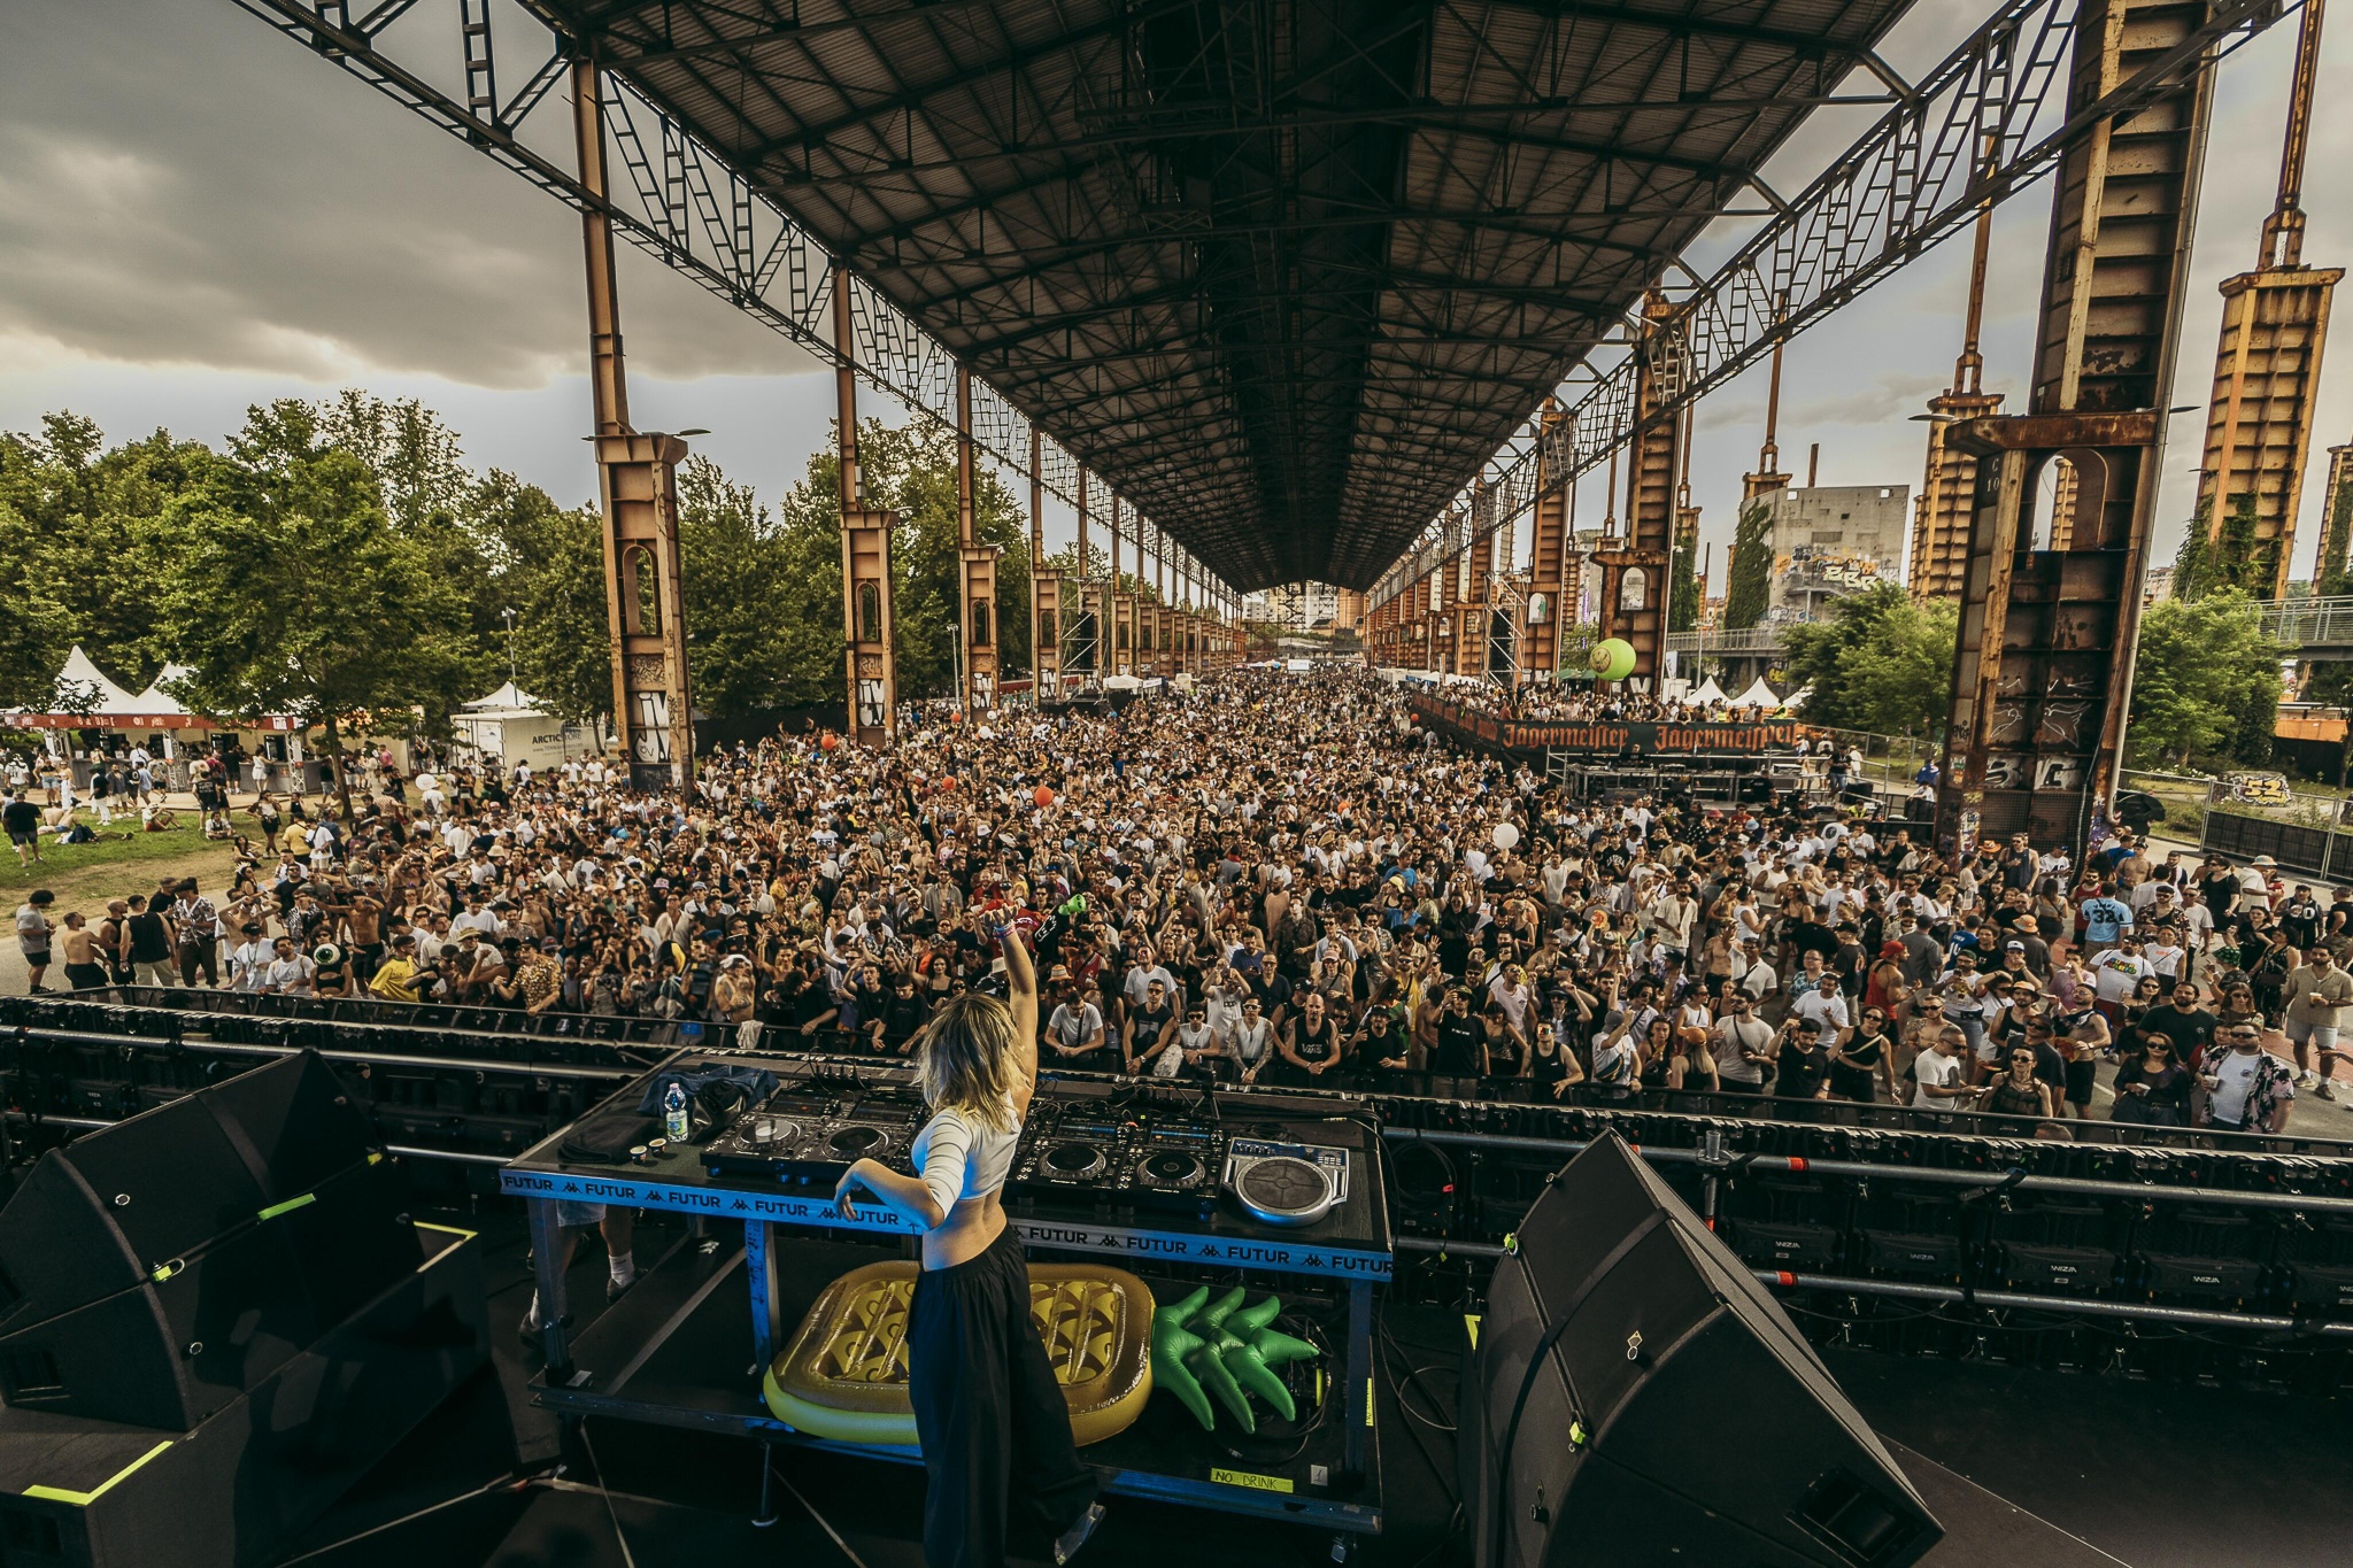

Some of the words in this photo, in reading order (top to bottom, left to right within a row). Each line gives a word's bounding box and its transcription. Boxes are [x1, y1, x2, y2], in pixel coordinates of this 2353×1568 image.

[1992, 458, 1999, 472] C
[1986, 477, 2000, 492] 10
[1502, 723, 1629, 751] Jägermeister
[2092, 909, 2118, 923] 32
[505, 1176, 554, 1191] FUTUR
[585, 1183, 636, 1199] FUTUR
[668, 1192, 721, 1208] FUTUR
[755, 1200, 809, 1217] FUTUR
[854, 1210, 900, 1225] UTUR
[1029, 1227, 1089, 1245] FUTUR
[1126, 1237, 1187, 1254] FUTUR
[1227, 1246, 1290, 1264] FUTUR
[1332, 1256, 1394, 1273] FUTUR
[1215, 1470, 1233, 1483] NO
[1242, 1474, 1278, 1490] DRINK
